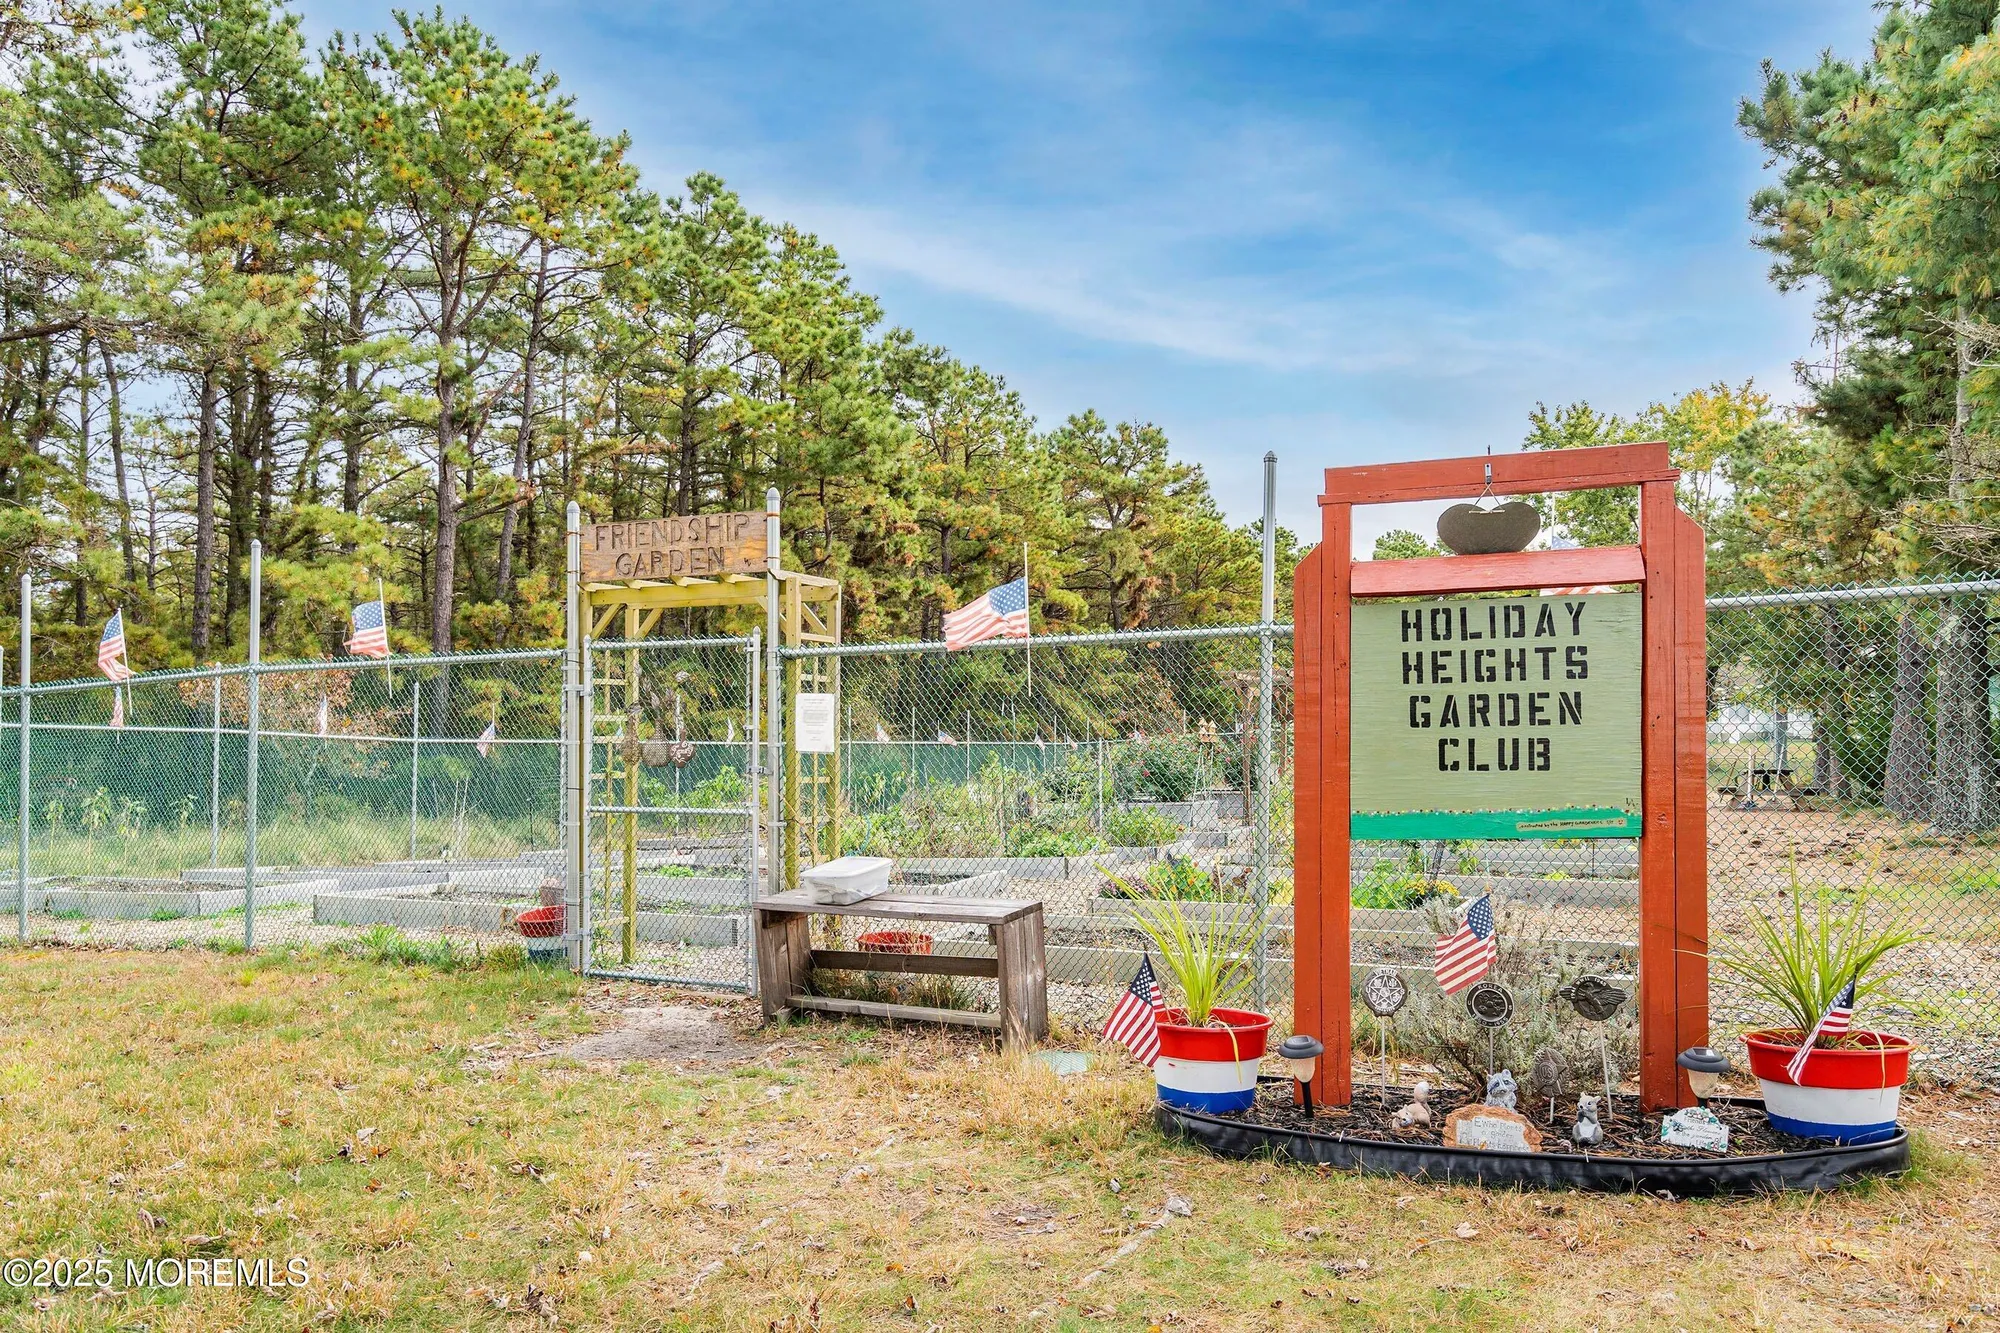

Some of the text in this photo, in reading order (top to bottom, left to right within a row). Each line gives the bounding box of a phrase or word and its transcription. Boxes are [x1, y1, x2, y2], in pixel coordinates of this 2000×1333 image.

[595, 513, 750, 551] FRIENDSHIP
[615, 546, 726, 577] GARDEN
[1400, 601, 1586, 643] HOLIDAY
[1402, 645, 1588, 685] HEIGHTS
[1408, 691, 1583, 729] GARDEN
[1437, 737, 1551, 772] CLUB
[1477, 983, 1503, 993] KOREA
[1541, 1066, 1553, 1079] US
